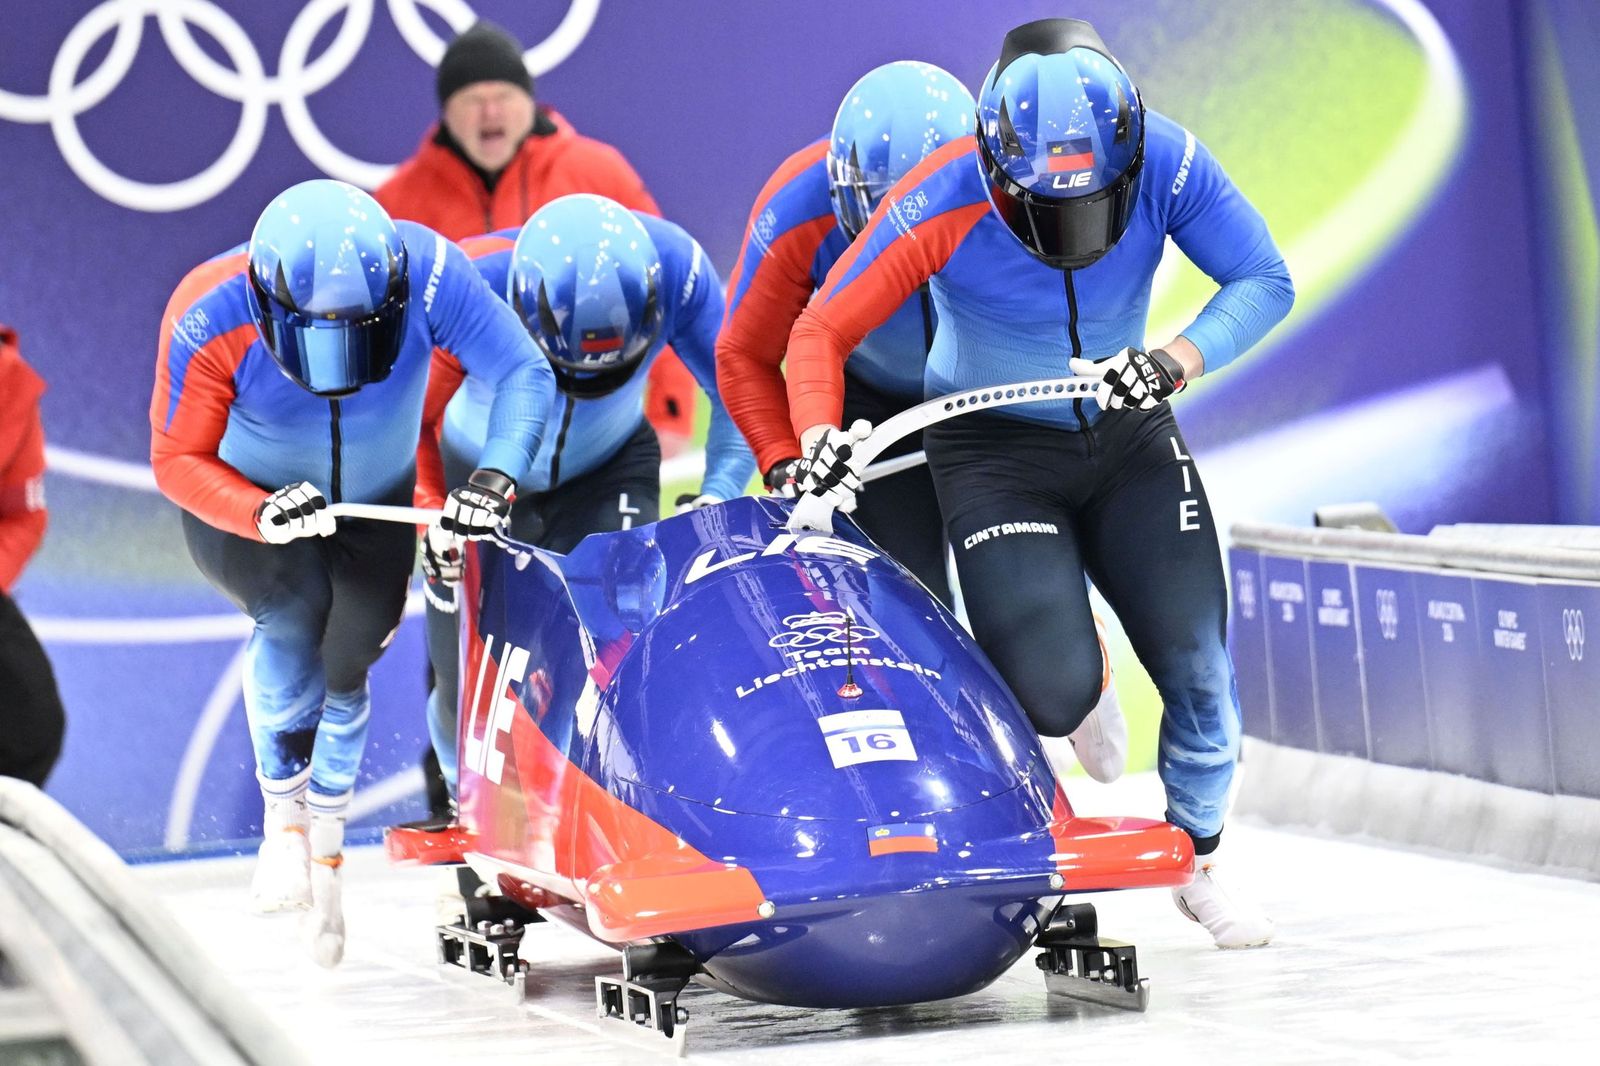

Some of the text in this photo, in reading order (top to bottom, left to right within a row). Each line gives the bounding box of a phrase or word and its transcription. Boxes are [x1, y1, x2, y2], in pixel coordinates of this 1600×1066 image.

[1052, 171, 1093, 189] LIE
[583, 350, 620, 365] LIE
[1169, 436, 1201, 532] LIE
[619, 492, 640, 531] LI
[963, 521, 1059, 551] CINTAMANI
[684, 533, 881, 585] LIE
[785, 646, 871, 662] Team
[735, 656, 943, 699] Liechtenstein
[464, 633, 531, 786] LIE
[841, 733, 897, 754] 16
